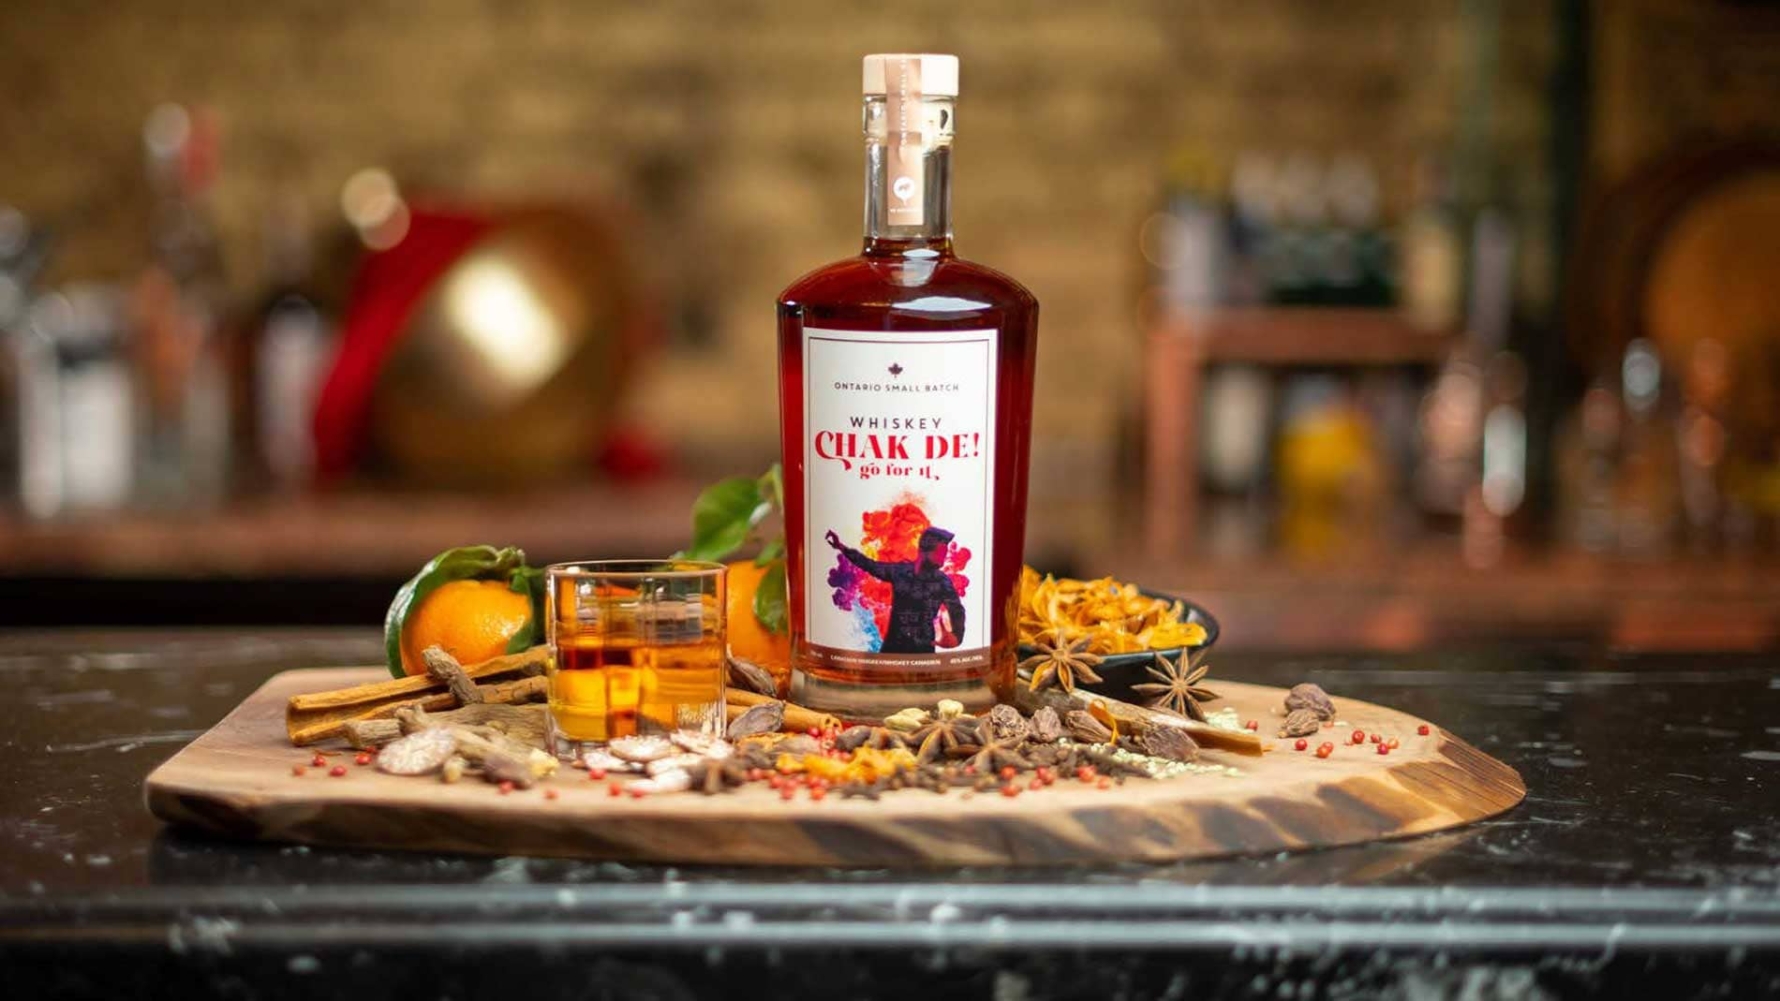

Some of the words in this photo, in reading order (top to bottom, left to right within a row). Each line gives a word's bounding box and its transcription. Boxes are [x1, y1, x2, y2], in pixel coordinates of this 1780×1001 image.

[834, 382, 881, 392] ONTARIO
[886, 384, 920, 392] SMALL
[925, 384, 959, 392] BATCH
[850, 416, 942, 429] WHISKEY
[815, 430, 909, 471] CHAK
[925, 432, 979, 460] DE!
[860, 462, 880, 479] go
[886, 463, 913, 476] for
